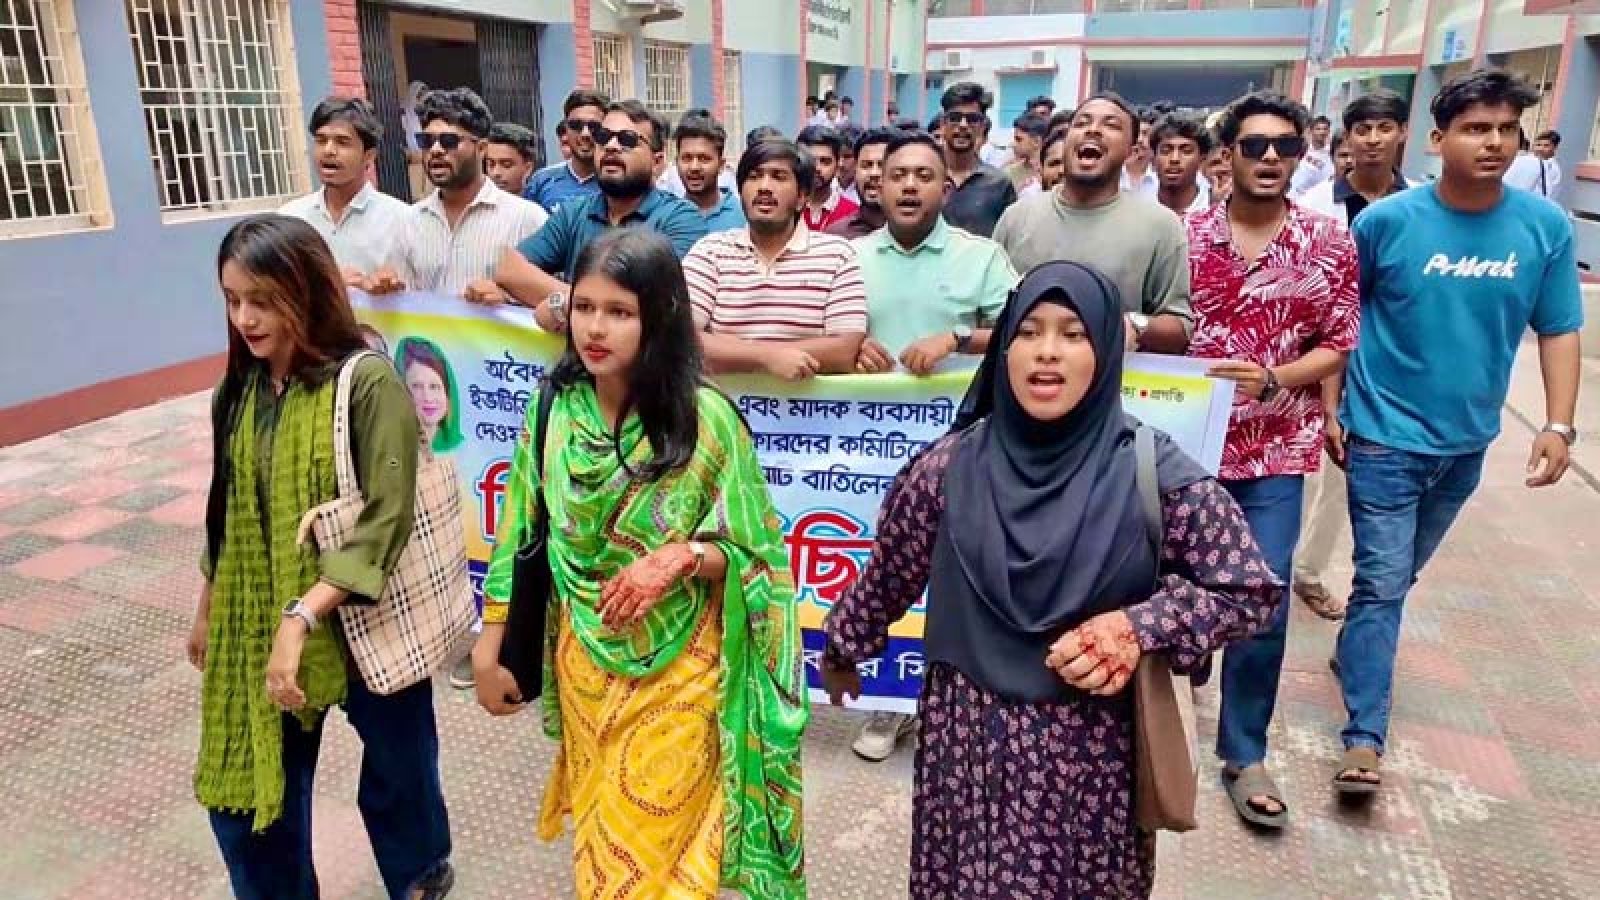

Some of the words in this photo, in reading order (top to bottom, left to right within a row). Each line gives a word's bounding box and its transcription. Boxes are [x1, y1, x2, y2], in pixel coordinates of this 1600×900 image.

[739, 395, 781, 420] এবং
[787, 397, 850, 419] মাদক
[858, 397, 955, 426] ব্যবসায়ী
